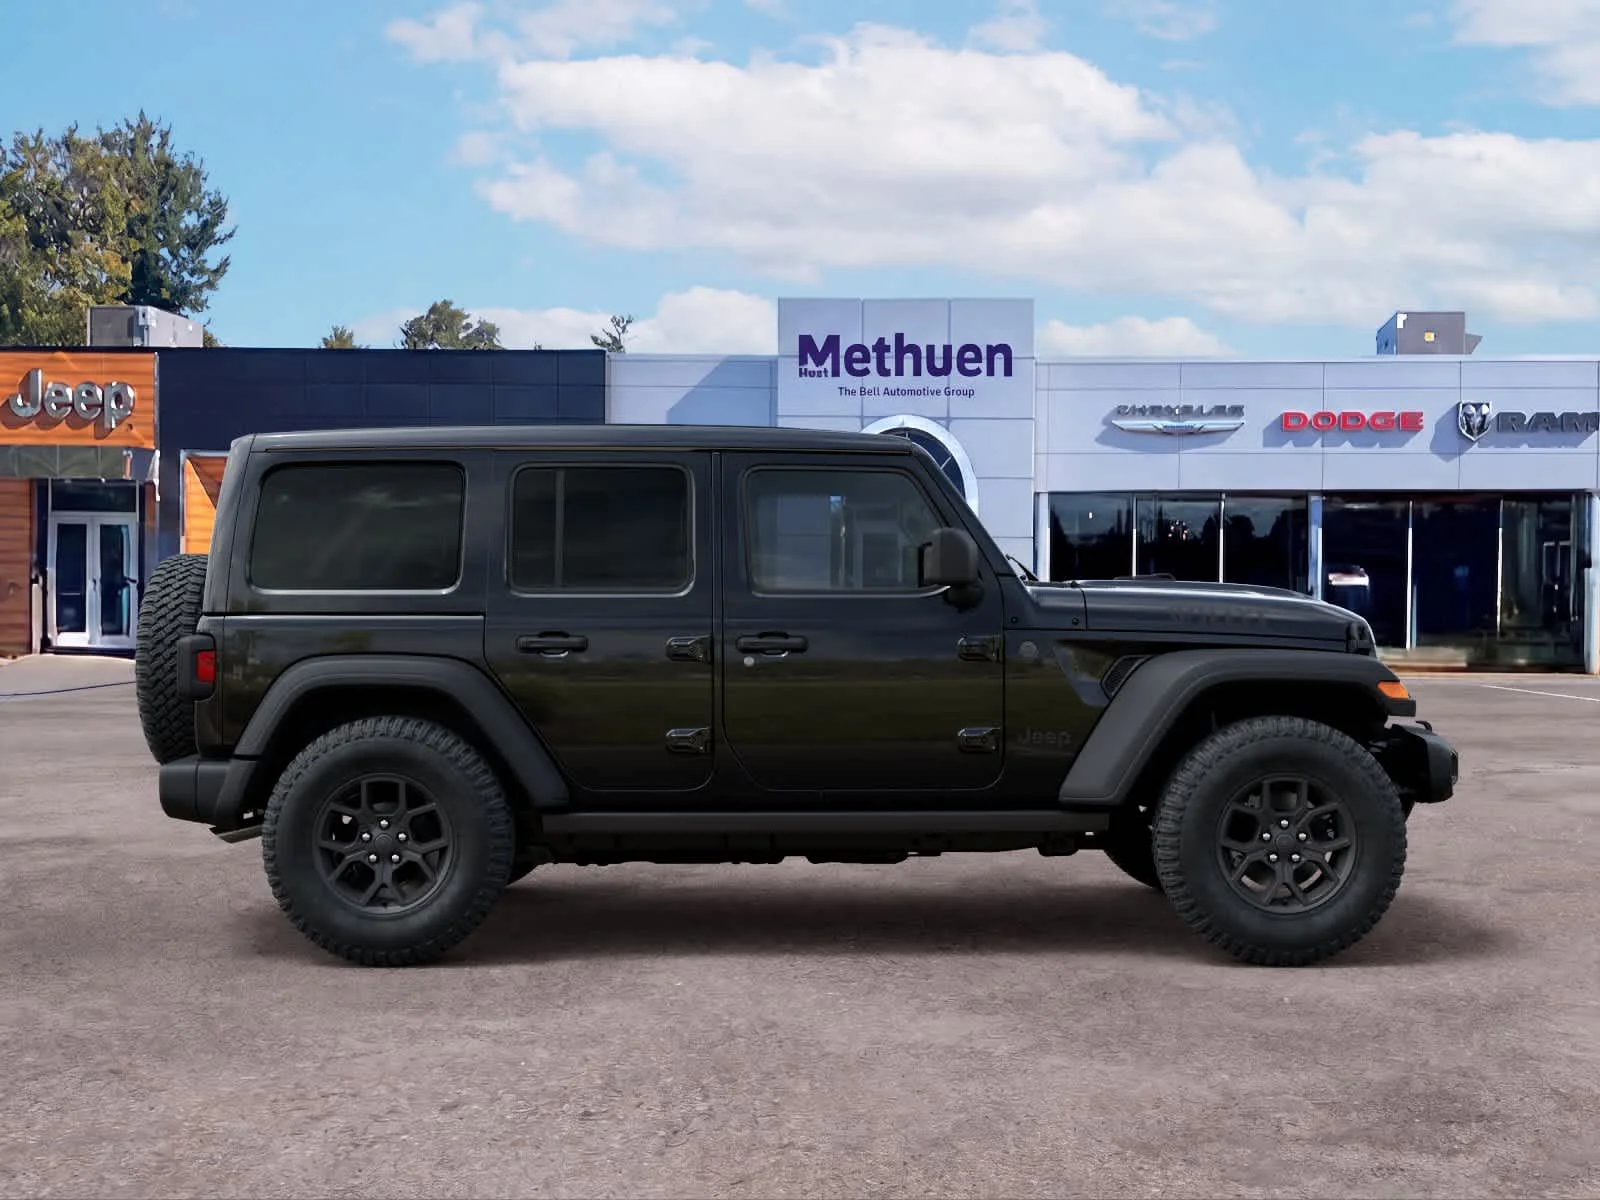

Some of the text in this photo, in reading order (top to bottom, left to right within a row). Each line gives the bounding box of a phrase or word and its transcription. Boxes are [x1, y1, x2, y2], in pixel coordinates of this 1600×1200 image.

[798, 332, 1013, 378] Methuen
[9, 367, 135, 429] Jeep
[838, 386, 975, 399] The Bell Automotive Group
[1282, 411, 1424, 432] DODGE
[1497, 411, 1600, 433] RAM
